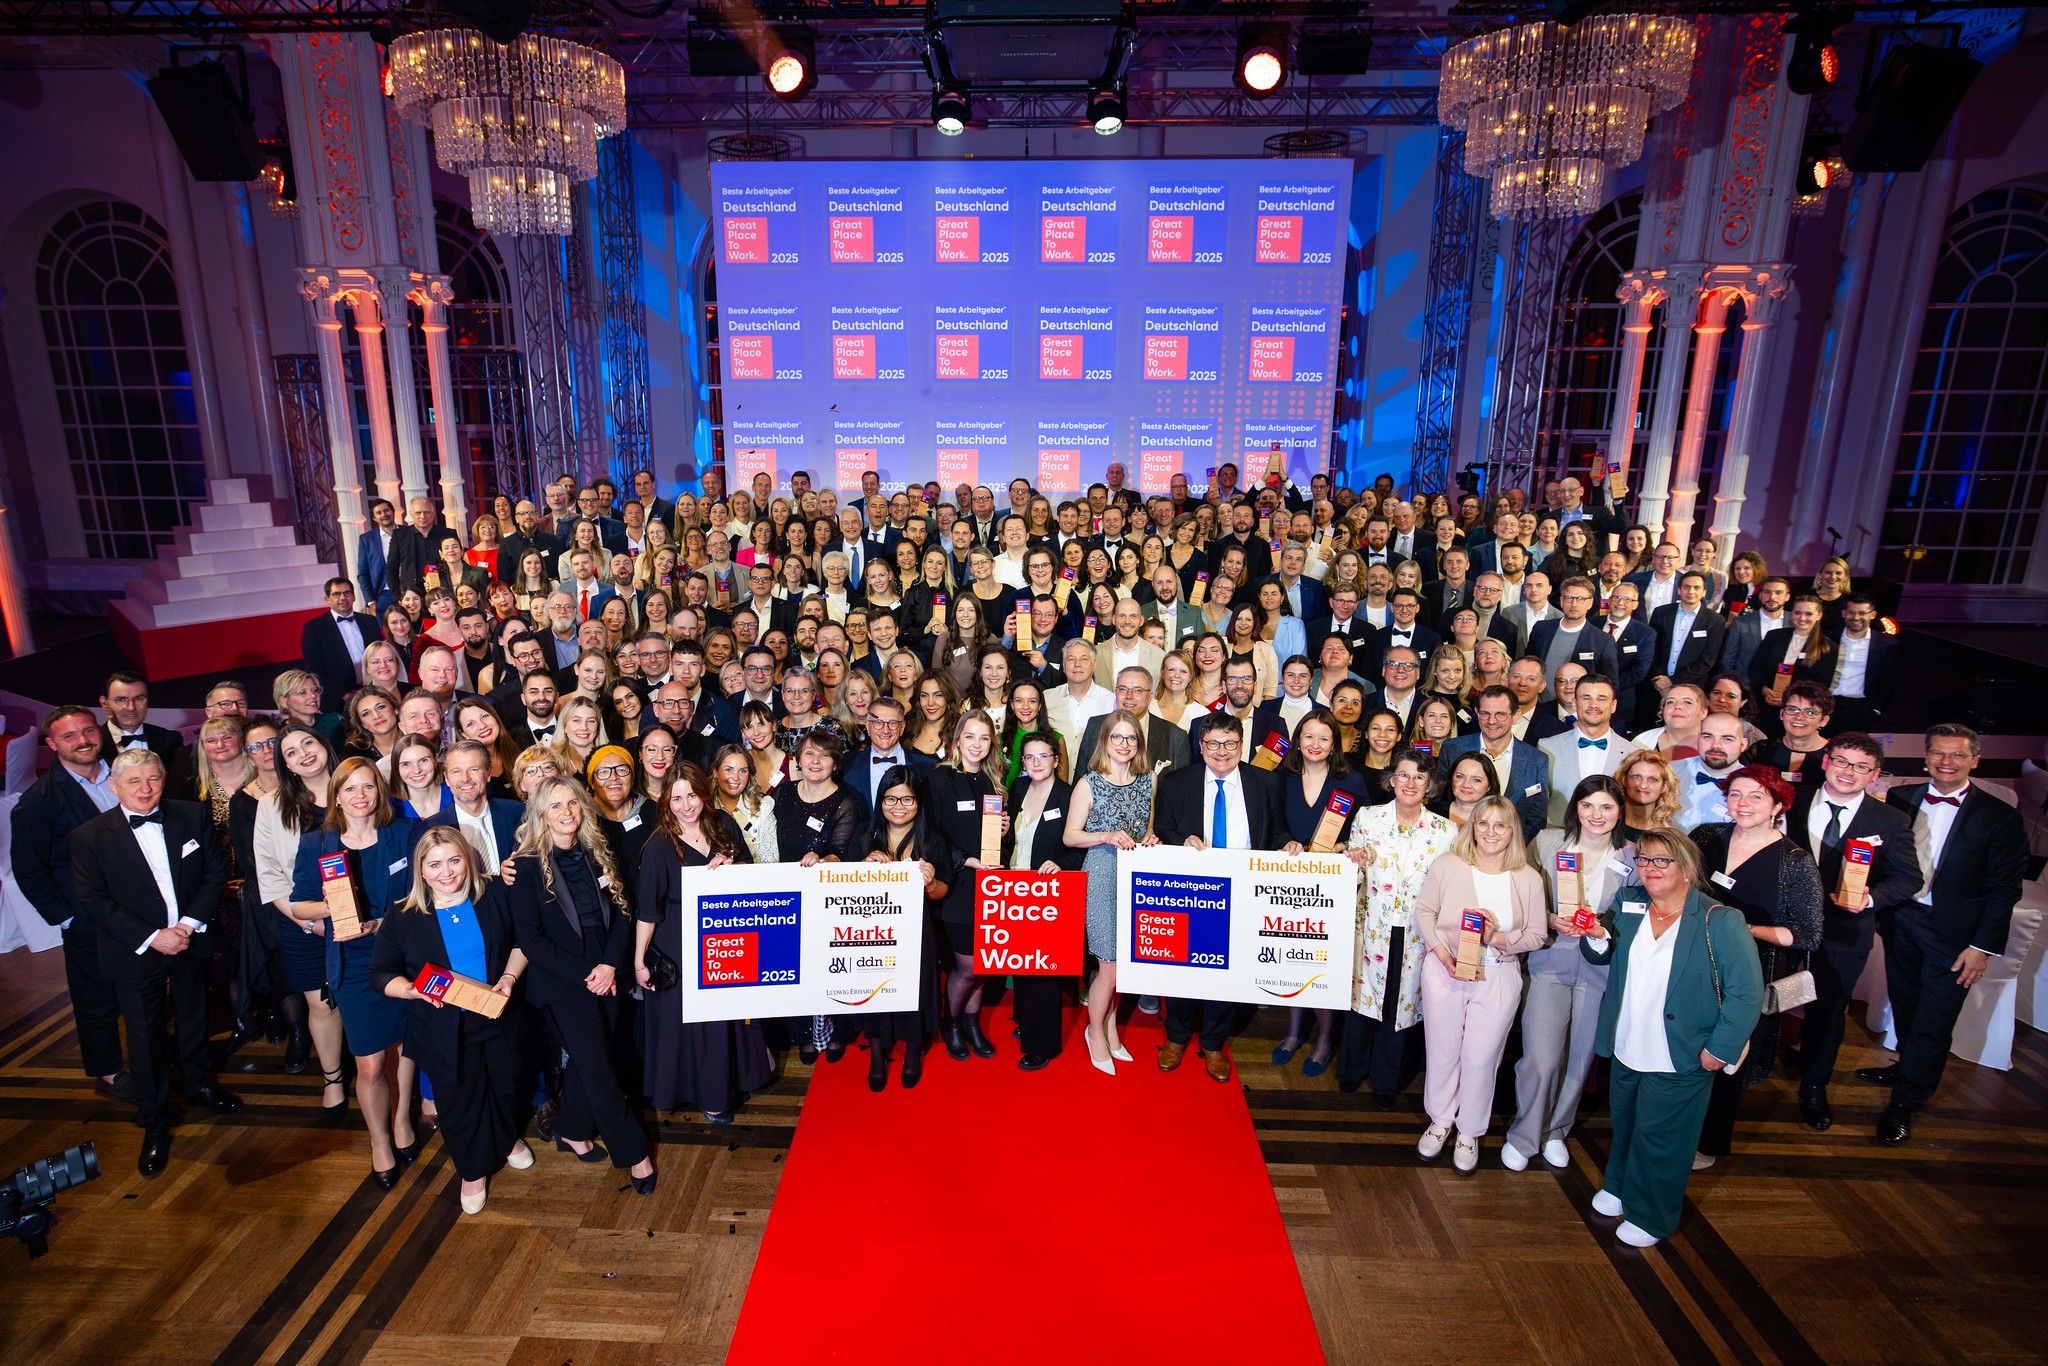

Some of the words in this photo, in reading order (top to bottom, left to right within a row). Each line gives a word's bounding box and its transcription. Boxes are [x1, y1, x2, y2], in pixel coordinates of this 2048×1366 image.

[723, 201, 796, 212] Deutschland
[829, 201, 902, 211] Deutschland
[936, 201, 1008, 211] Deutschland
[1042, 200, 1116, 211] Deutschland
[1150, 200, 1224, 211] Deutschland
[1259, 200, 1334, 211] Deutschland
[727, 221, 756, 230] Great
[833, 220, 862, 229] Great
[939, 220, 968, 229] Great
[1045, 220, 1075, 229] Great
[1152, 219, 1182, 228] Great
[1261, 219, 1291, 228] Great
[728, 231, 757, 239] Place
[834, 230, 862, 239] Place
[939, 230, 968, 239] Place
[1046, 230, 1074, 238] Place
[1153, 229, 1181, 238] Place
[1261, 229, 1290, 239] Place
[728, 241, 739, 249] To
[833, 240, 844, 249] To
[939, 240, 950, 249] To
[1045, 240, 1056, 248] To
[1152, 240, 1163, 248] To
[1260, 240, 1271, 249] To
[772, 253, 798, 263] 2025
[877, 253, 903, 262] 2025
[982, 253, 1009, 262] 2025
[1088, 253, 1115, 262] 2025
[1195, 253, 1222, 262] 2025
[1303, 253, 1331, 263] 2025
[729, 320, 800, 331] Deutschland
[832, 320, 903, 330] Deutschland
[936, 320, 1008, 330] Deutschland
[1041, 320, 1112, 330] Deutschland
[1146, 320, 1218, 331] Deutschland
[1252, 321, 1325, 332] Deutschland
[733, 339, 761, 347] Great
[836, 338, 864, 347] Great
[939, 338, 968, 346] Great
[1043, 338, 1072, 347] Great
[1148, 338, 1177, 347] Great
[1254, 339, 1283, 349] Great
[734, 348, 761, 357] Place
[837, 348, 864, 356] Place
[940, 347, 968, 356] Place
[1044, 348, 1072, 356] Place
[1148, 348, 1176, 357] Place
[1254, 349, 1282, 358] Place
[734, 358, 744, 366] To
[836, 358, 847, 366] To
[939, 357, 950, 365] To
[1043, 357, 1054, 366] To
[1147, 358, 1158, 366] To
[1253, 359, 1264, 368] To
[776, 370, 802, 379] 2025
[879, 370, 905, 379] 2025
[982, 370, 1008, 379] 2025
[1085, 370, 1112, 379] 2025
[1190, 371, 1216, 380] 2025
[1295, 372, 1322, 382] 2025
[734, 434, 803, 444] Deutschland
[835, 434, 905, 444] Deutschland
[937, 434, 1006, 444] Deutschland
[1039, 435, 1109, 445] Deutschland
[1141, 436, 1212, 446] Deutschland
[939, 452, 968, 460] Great
[1041, 452, 1069, 461] Great
[1144, 453, 1172, 462] Great
[940, 461, 967, 470] Place
[1042, 462, 1069, 470] Place
[1144, 463, 1171, 471] Place
[1250, 858, 1342, 874] Handelsblatt
[820, 870, 908, 883] Handelsblatt
[981, 875, 1060, 897] Great
[1136, 878, 1161, 887] Beste
[1254, 883, 1324, 898] personal.
[824, 892, 893, 909] personal.
[1136, 893, 1225, 909] Deutschland
[1269, 894, 1334, 909] magazin
[839, 904, 902, 919] magazin
[983, 900, 1058, 921] Place
[703, 913, 796, 928] Deutschland
[1139, 914, 1175, 925] Great
[1263, 916, 1326, 934] Markt
[834, 925, 894, 940] Markt
[980, 925, 1009, 944] To
[1139, 924, 1174, 936] Place
[706, 937, 744, 947] Great
[1139, 935, 1152, 945] To
[708, 949, 744, 958] Place
[1286, 948, 1314, 961] ddn
[856, 956, 882, 968] ddn
[1191, 953, 1224, 965] 2025
[706, 960, 721, 969] To
[762, 970, 795, 982] 2025
